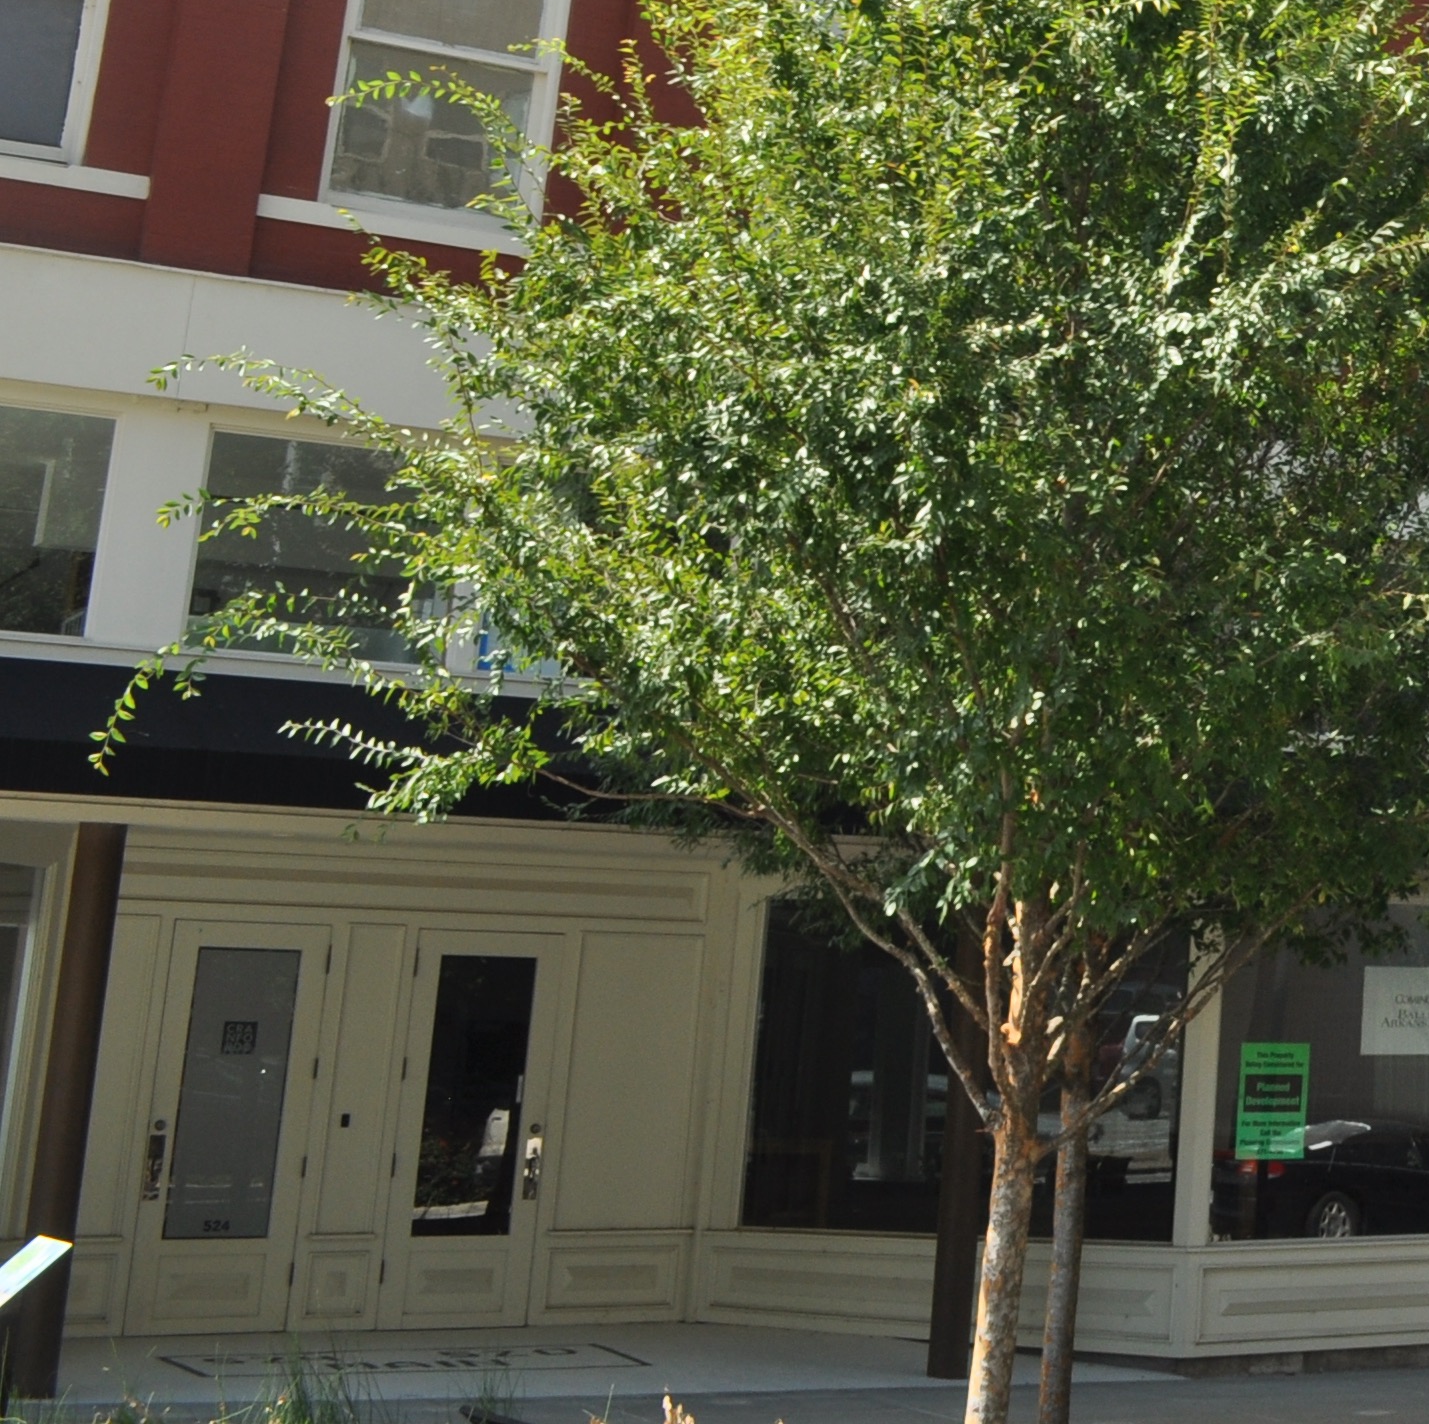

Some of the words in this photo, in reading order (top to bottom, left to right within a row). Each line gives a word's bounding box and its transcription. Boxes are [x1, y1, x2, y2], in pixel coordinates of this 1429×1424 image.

[1257, 1082, 1290, 1092] Planned
[1246, 1096, 1299, 1107] Development
[203, 1220, 230, 1232] 524
